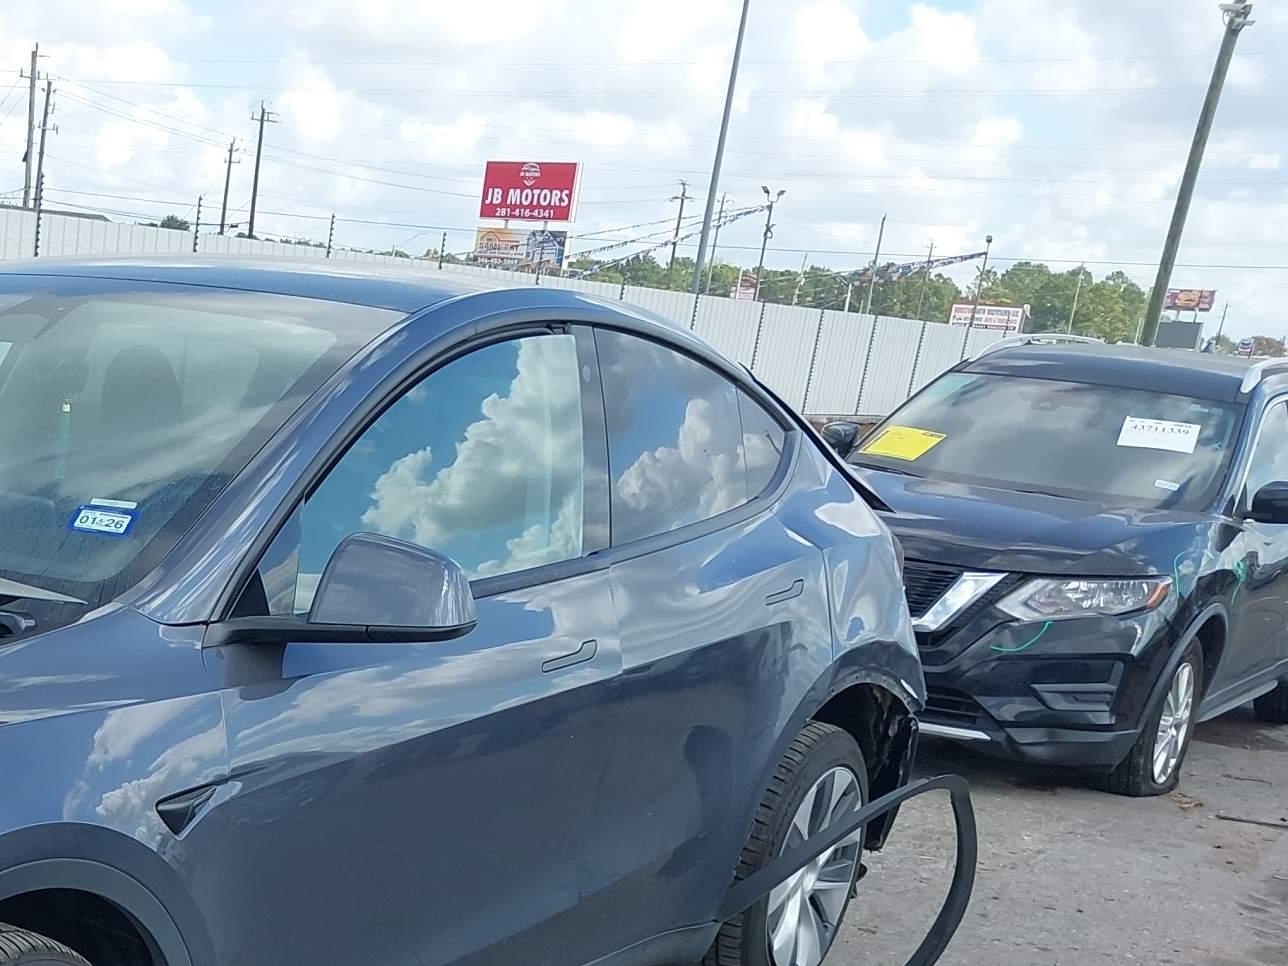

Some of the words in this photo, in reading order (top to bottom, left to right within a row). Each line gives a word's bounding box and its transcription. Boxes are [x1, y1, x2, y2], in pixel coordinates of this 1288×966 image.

[485, 187, 503, 204] JB
[507, 188, 570, 206] MOTORS
[495, 207, 554, 218] 281-416-4341
[79, 515, 97, 525] 01
[105, 518, 125, 529] 26
